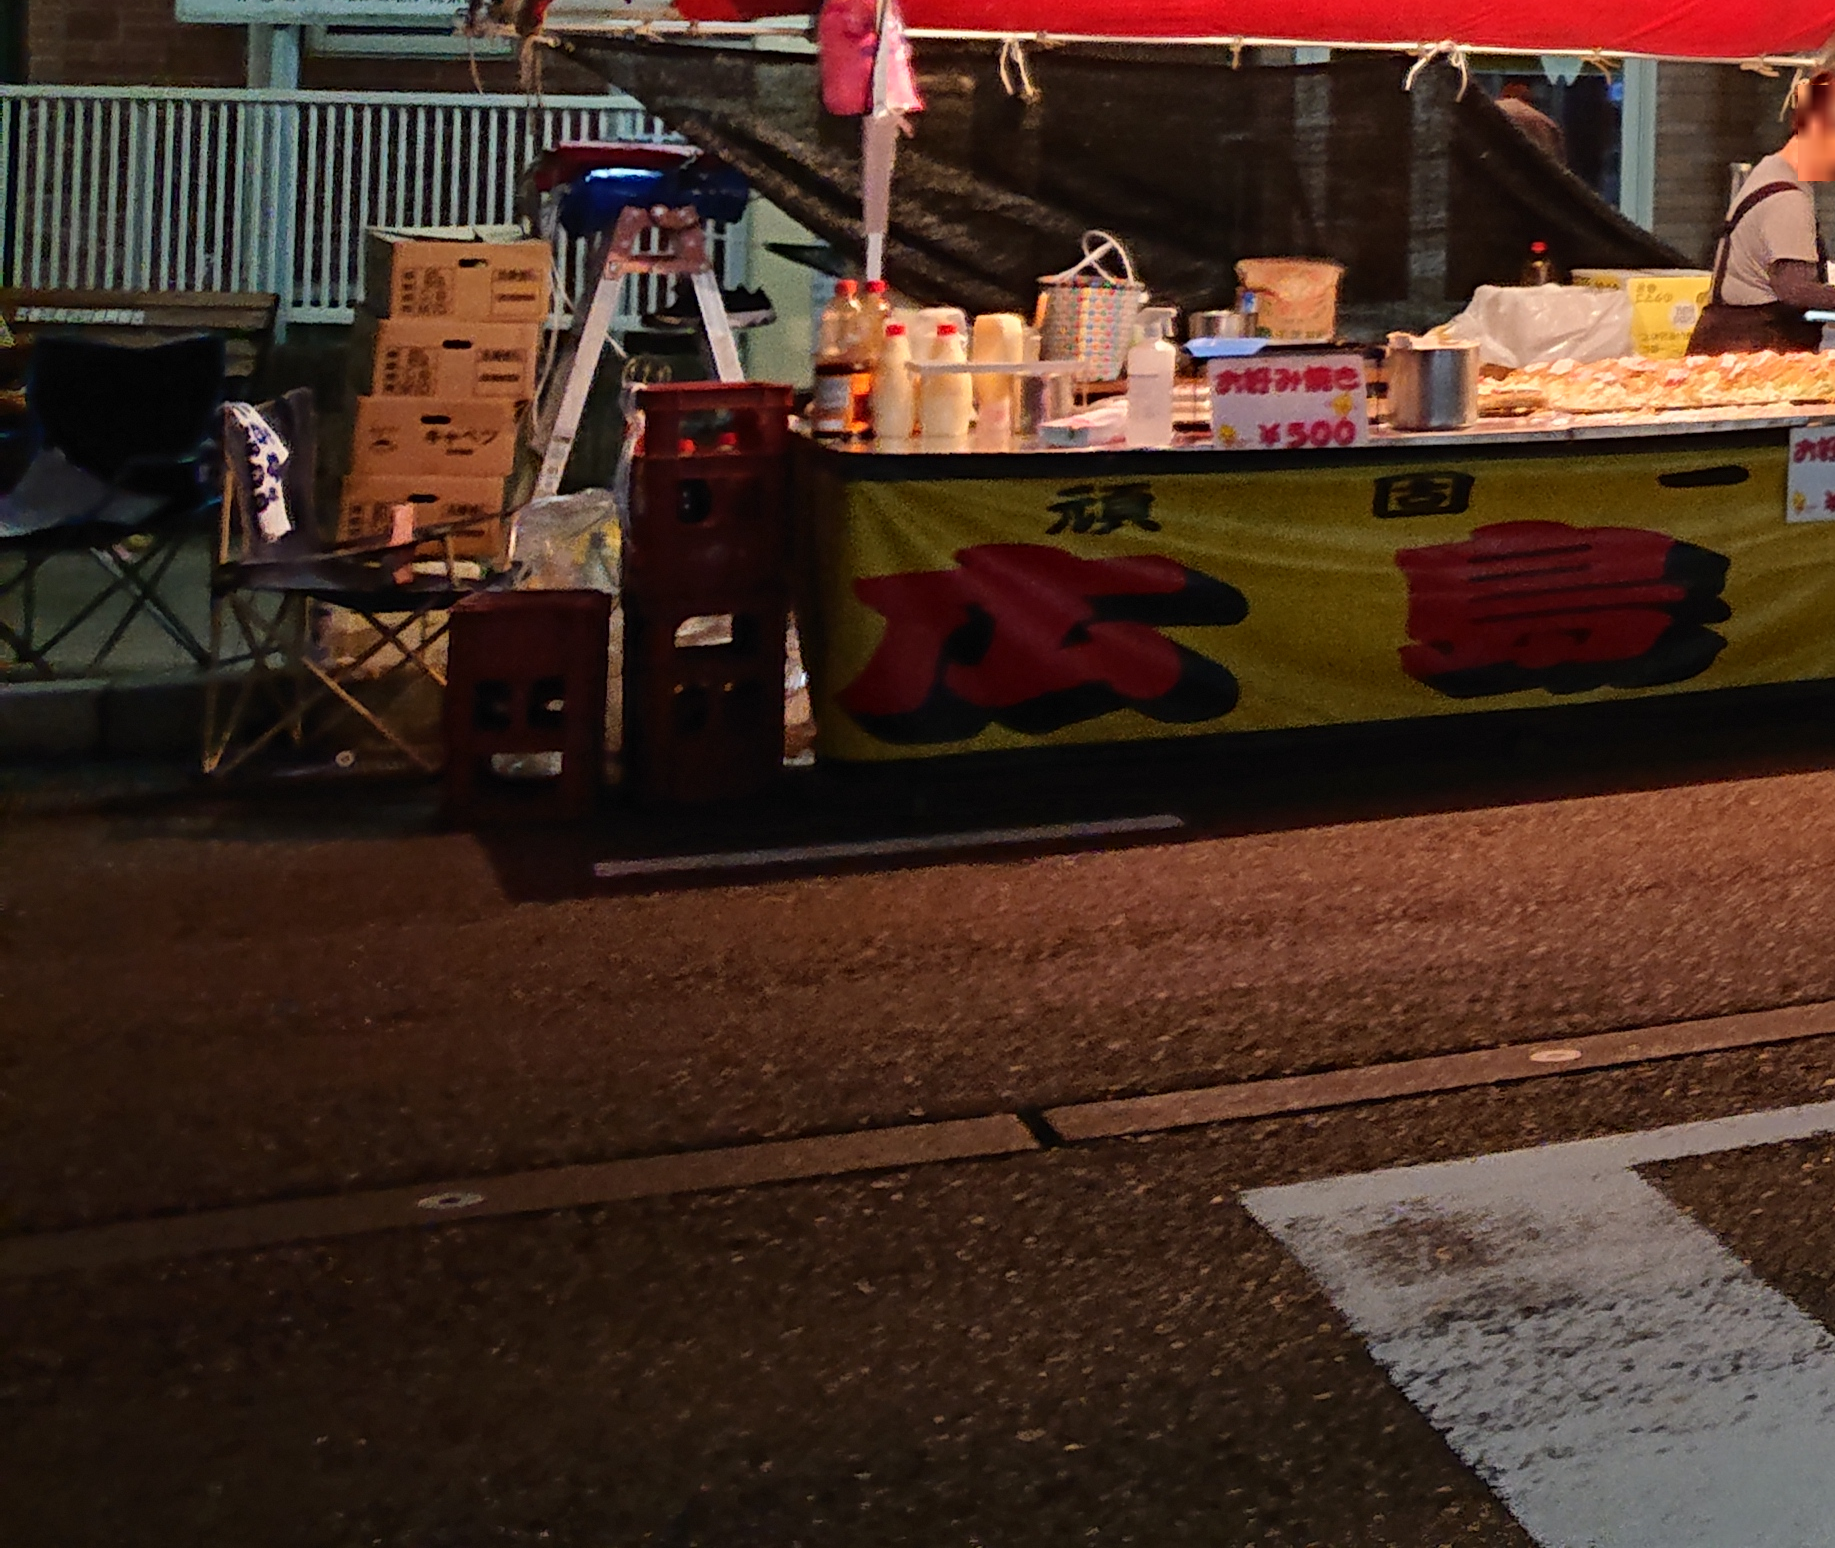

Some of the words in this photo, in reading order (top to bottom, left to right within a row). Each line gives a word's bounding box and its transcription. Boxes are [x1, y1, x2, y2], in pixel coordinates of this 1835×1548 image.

[1216, 365, 1360, 395] お好み焼き
[1258, 417, 1356, 449] ¥500
